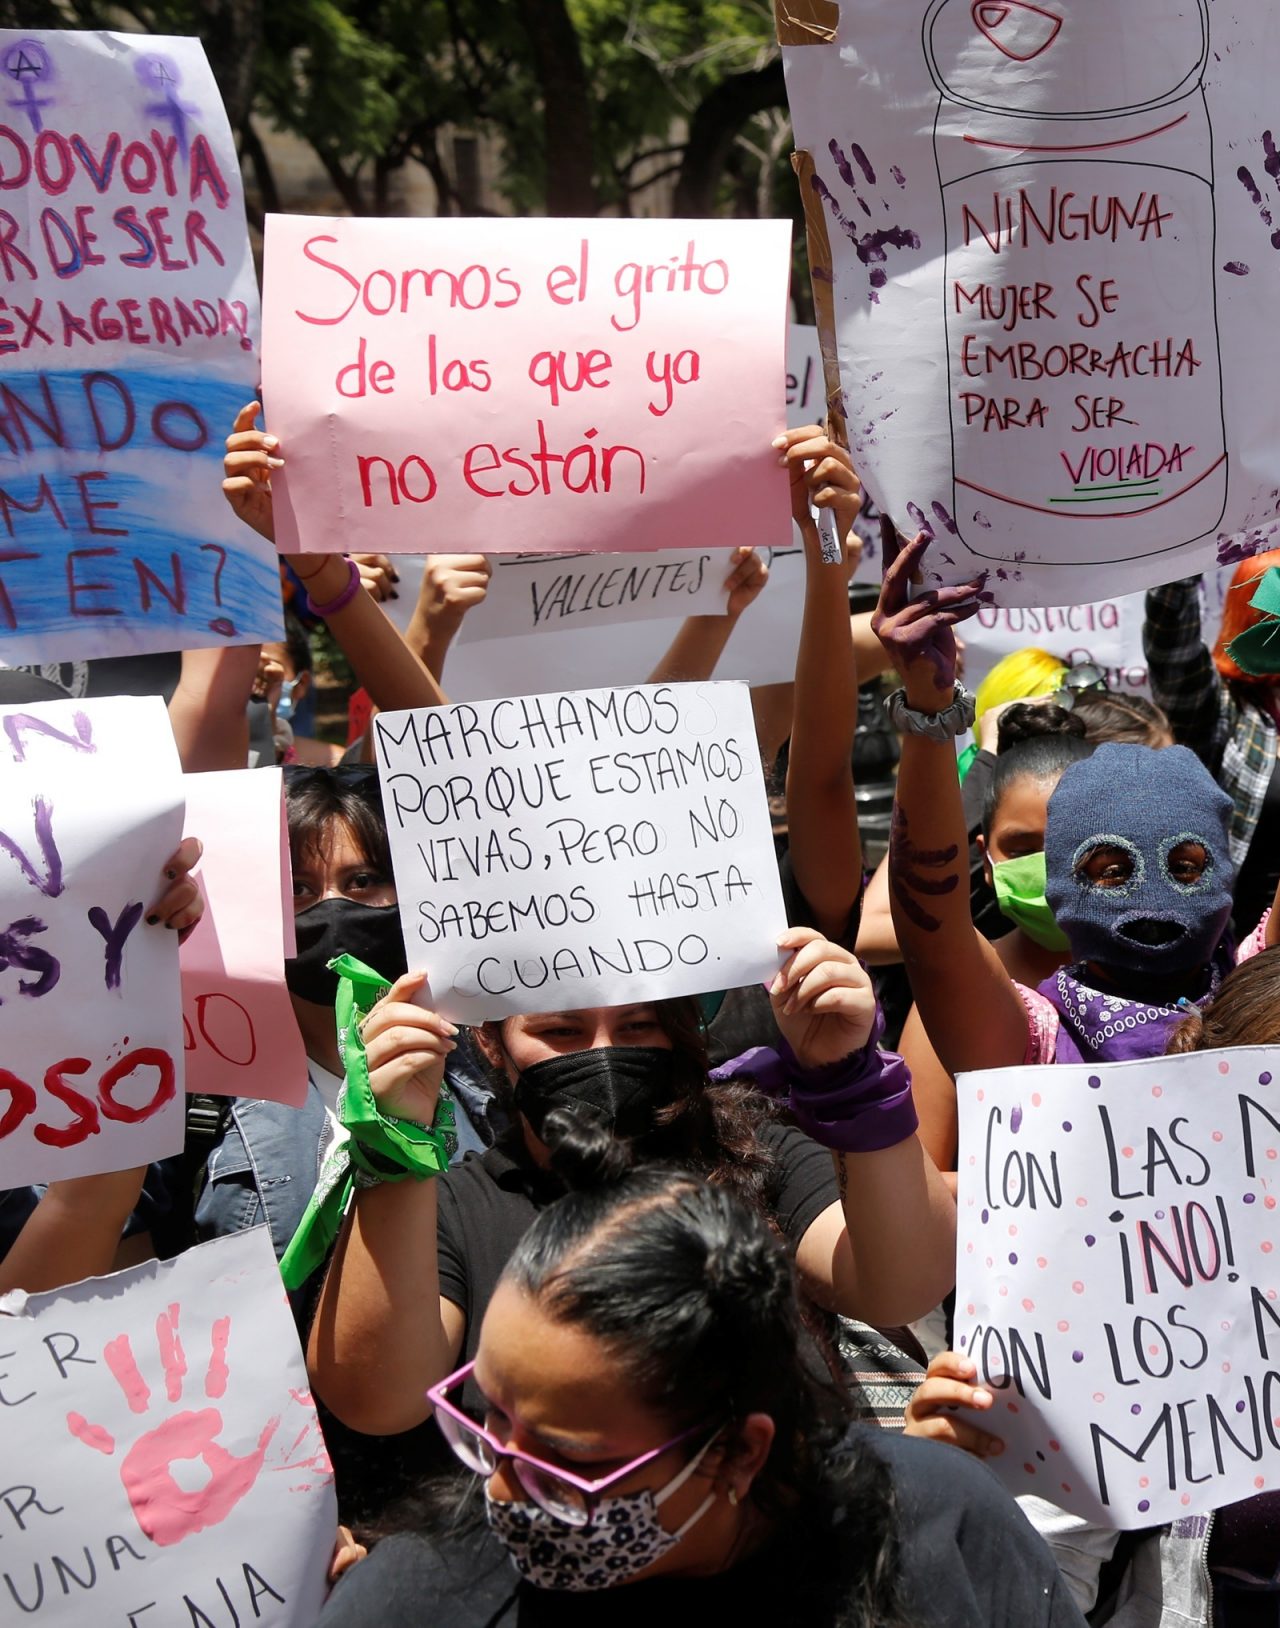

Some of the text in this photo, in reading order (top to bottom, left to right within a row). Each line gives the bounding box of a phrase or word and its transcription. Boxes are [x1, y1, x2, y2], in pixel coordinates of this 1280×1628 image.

[112, 205, 225, 271] SER
[961, 186, 1174, 255] NINGUNA
[295, 235, 730, 332] Somos el grito
[953, 273, 1120, 333] MUJER SE
[335, 334, 702, 417] de las que ya
[961, 334, 1202, 382] EMBORRACHA
[959, 391, 1140, 433] PARA SER
[356, 418, 648, 508] no están
[1060, 441, 1196, 485] VIOLADA
[531, 555, 710, 626] VALIENTES
[374, 687, 680, 769] MARCHAMOS
[386, 738, 744, 829] PORQUE ESTAMOS
[689, 795, 739, 849] NO
[418, 864, 753, 943] SABEMOS HASTA
[87, 901, 144, 998] Y
[476, 934, 722, 996] CUANDO.
[985, 1105, 1062, 1211] CON
[1098, 1104, 1211, 1200] LAS
[1107, 1194, 1240, 1304] ¡NO!
[1103, 1304, 1209, 1386] LOS
[3, 1534, 147, 1613] UNA
